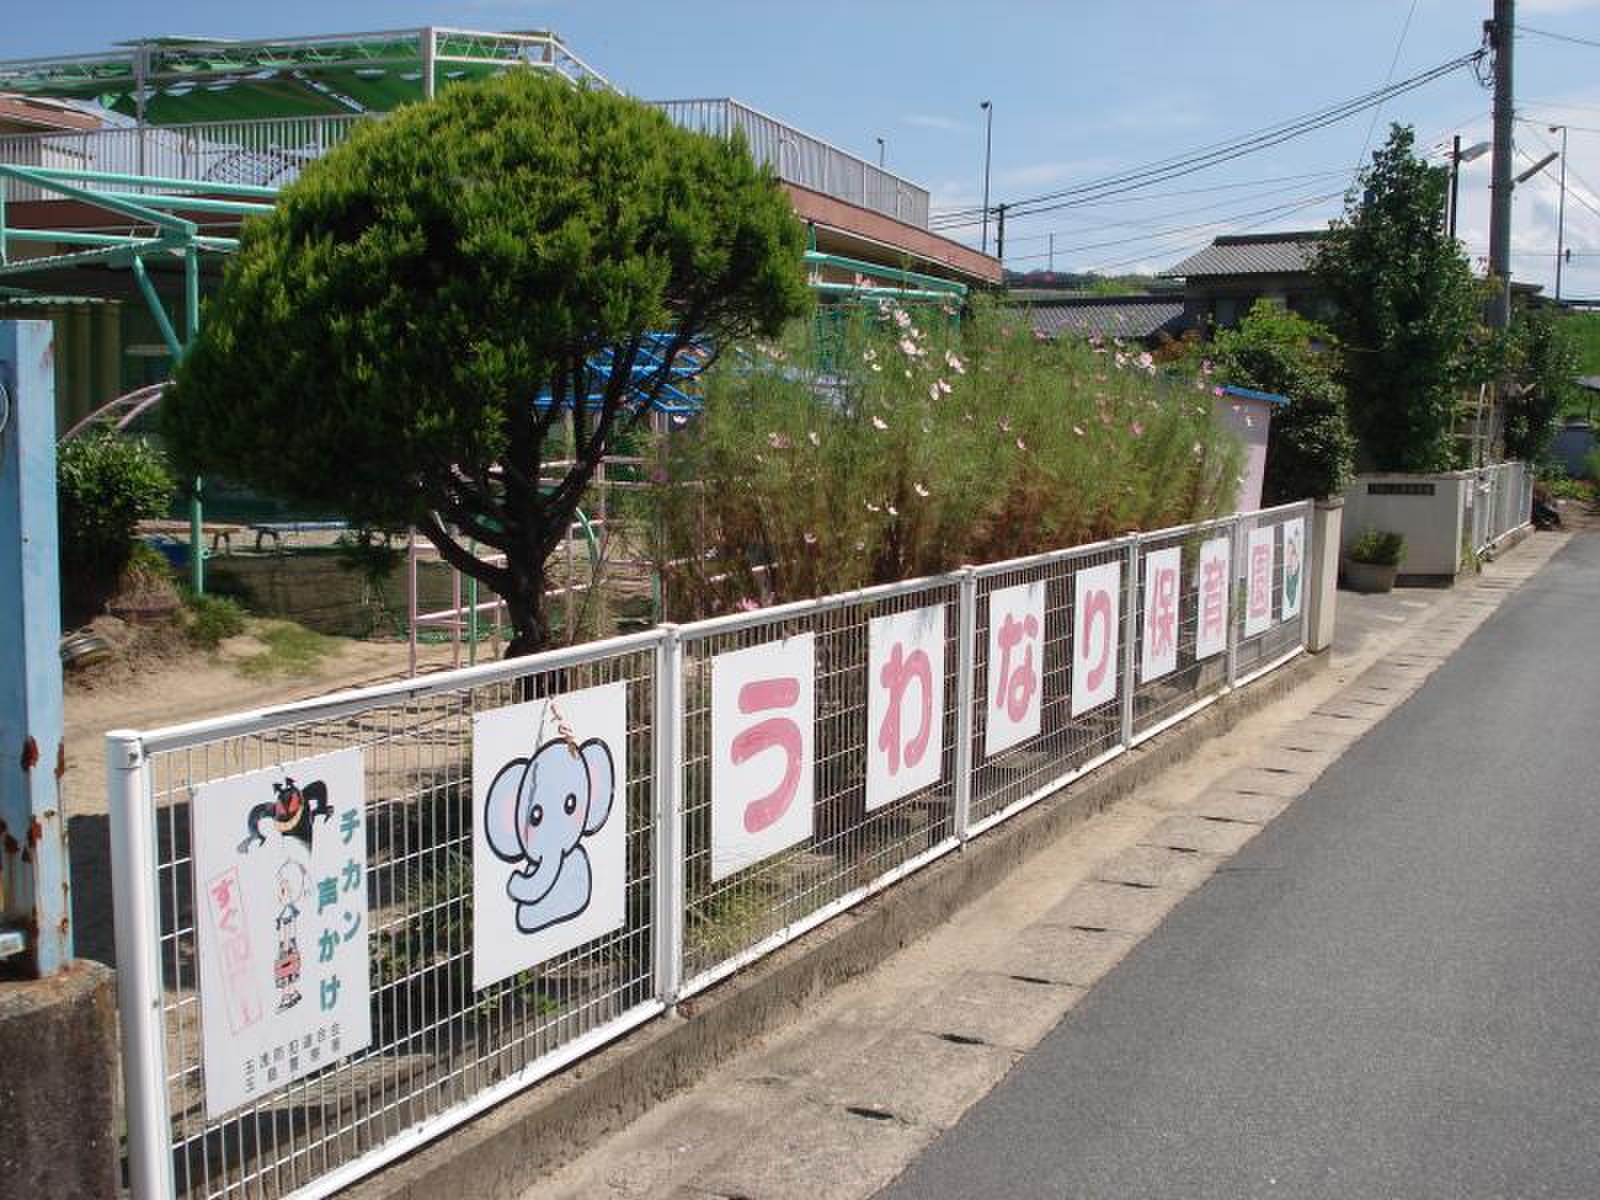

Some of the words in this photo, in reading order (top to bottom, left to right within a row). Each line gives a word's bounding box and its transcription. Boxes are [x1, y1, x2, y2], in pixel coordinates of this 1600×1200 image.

[339, 807, 361, 943] チカン
[317, 876, 342, 1013] 声かけ
